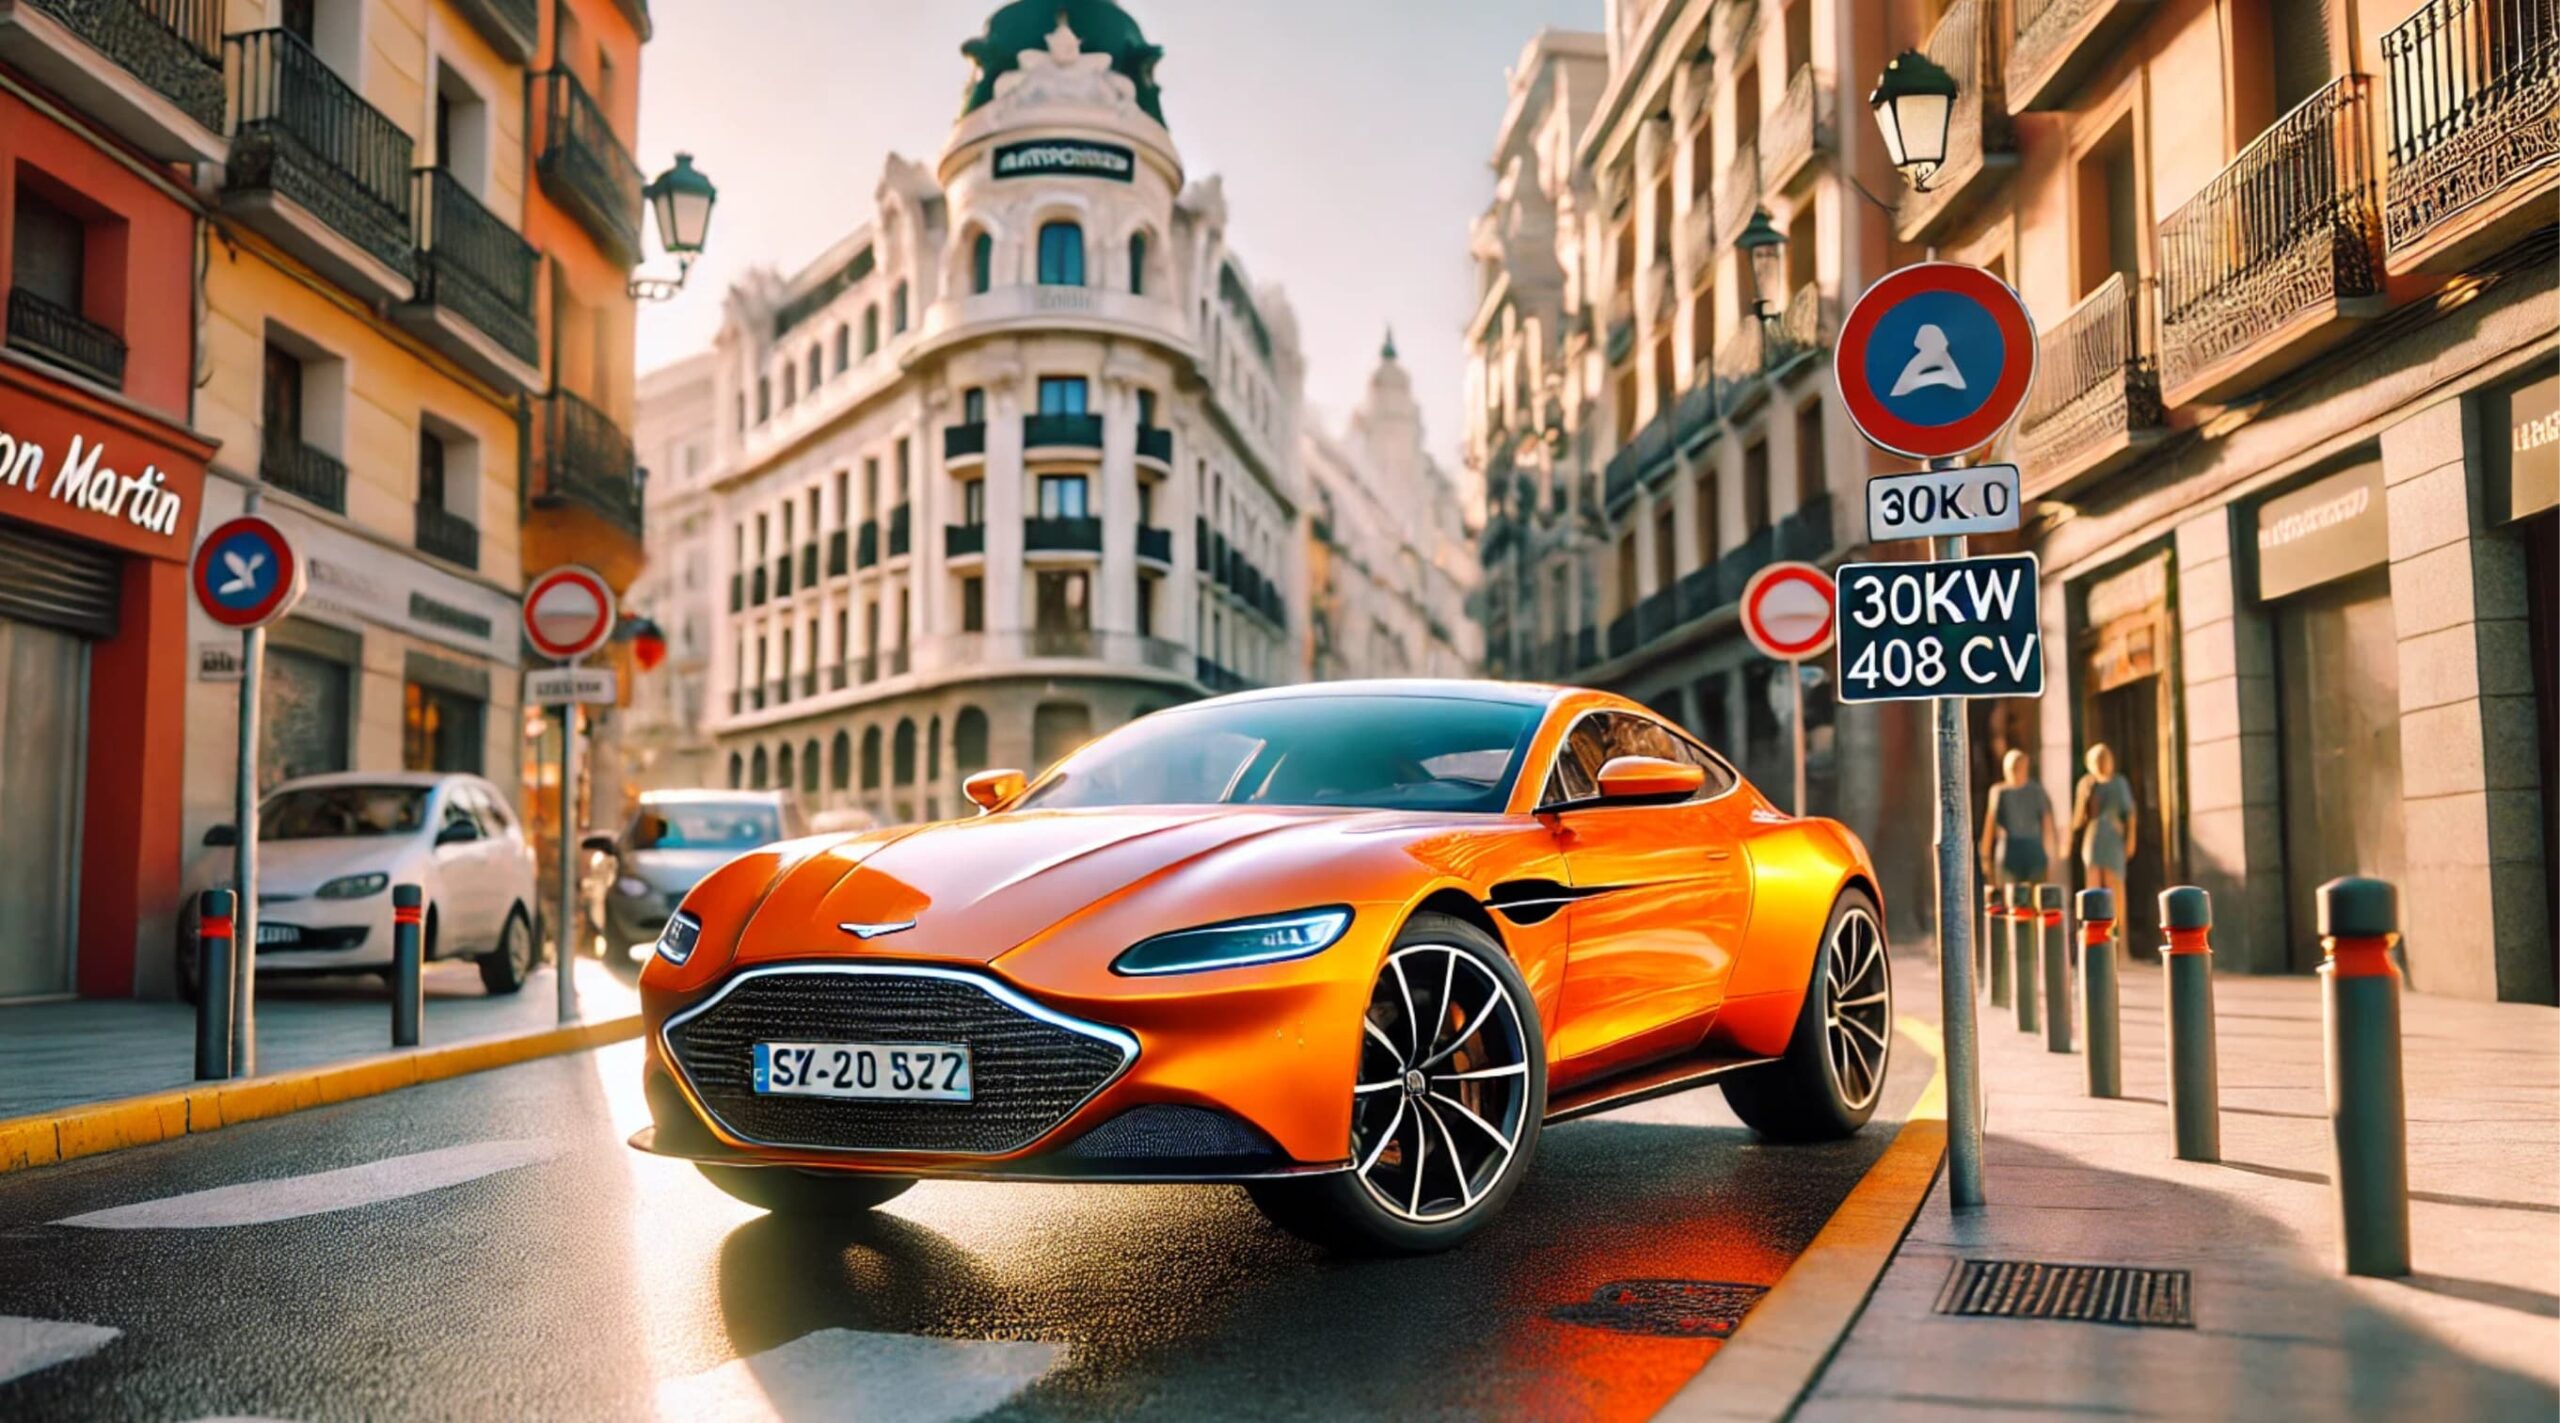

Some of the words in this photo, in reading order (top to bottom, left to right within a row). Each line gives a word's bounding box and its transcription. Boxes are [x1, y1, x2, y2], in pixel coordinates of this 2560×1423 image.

[50, 434, 181, 535] Martin
[1852, 568, 2021, 629] 30KW
[1847, 636, 1947, 689] 408
[1959, 633, 2037, 684] CV
